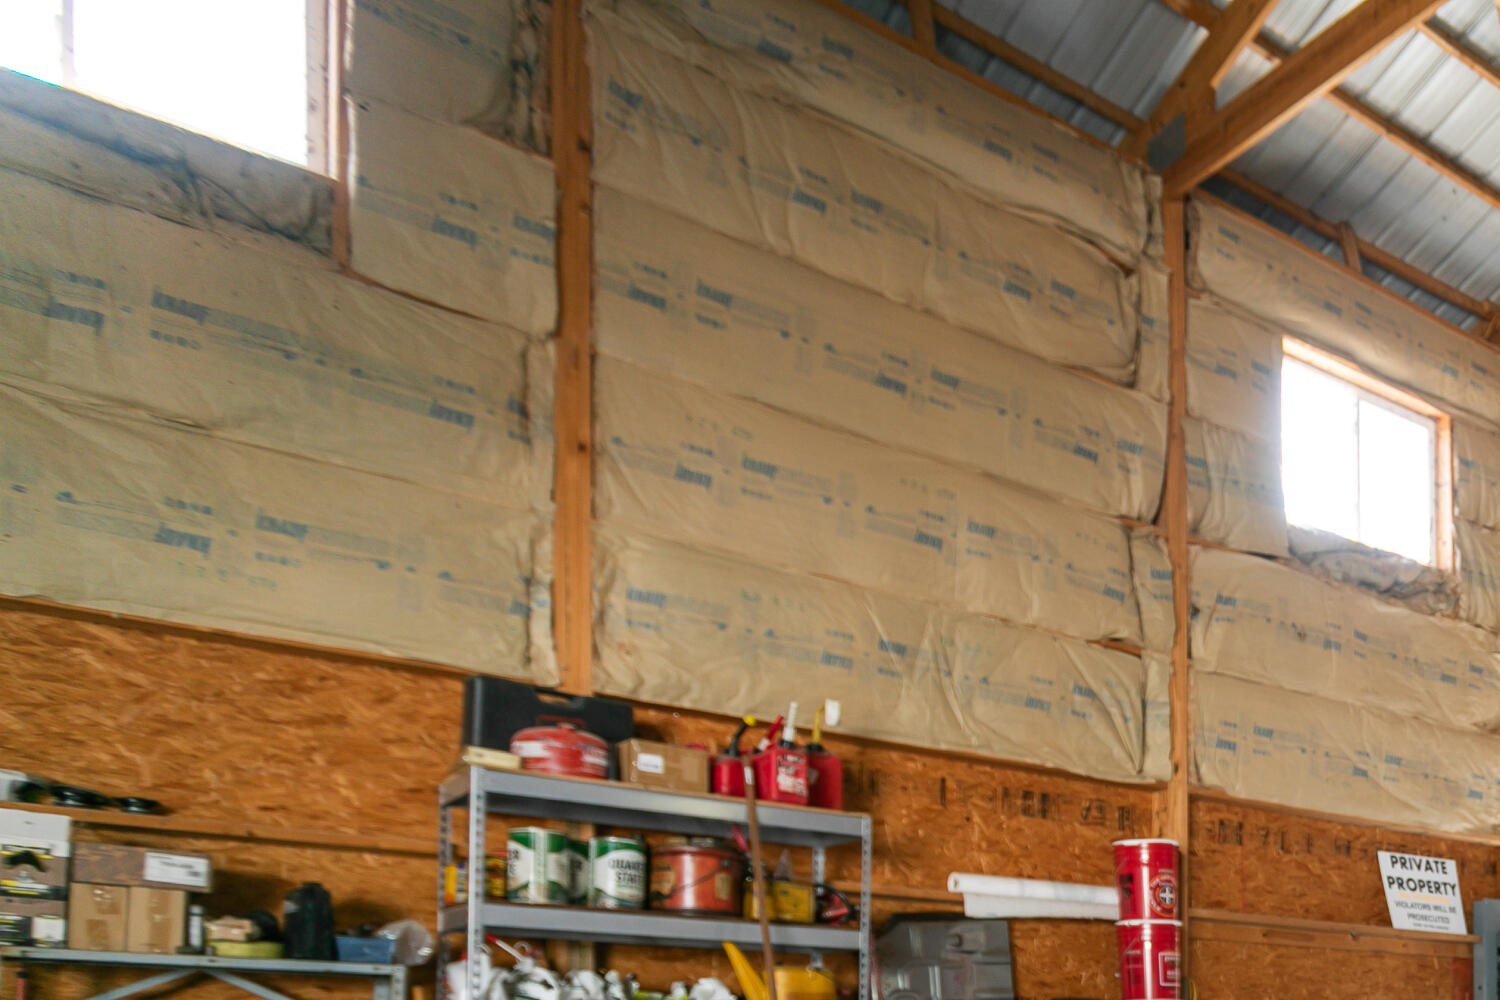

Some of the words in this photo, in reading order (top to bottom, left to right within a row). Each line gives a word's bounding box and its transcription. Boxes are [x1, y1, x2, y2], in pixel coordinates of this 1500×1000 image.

[1390, 855, 1448, 875] PRIVATE
[1386, 875, 1457, 897] PROPERTY
[1394, 900, 1431, 912] VIOLATORS
